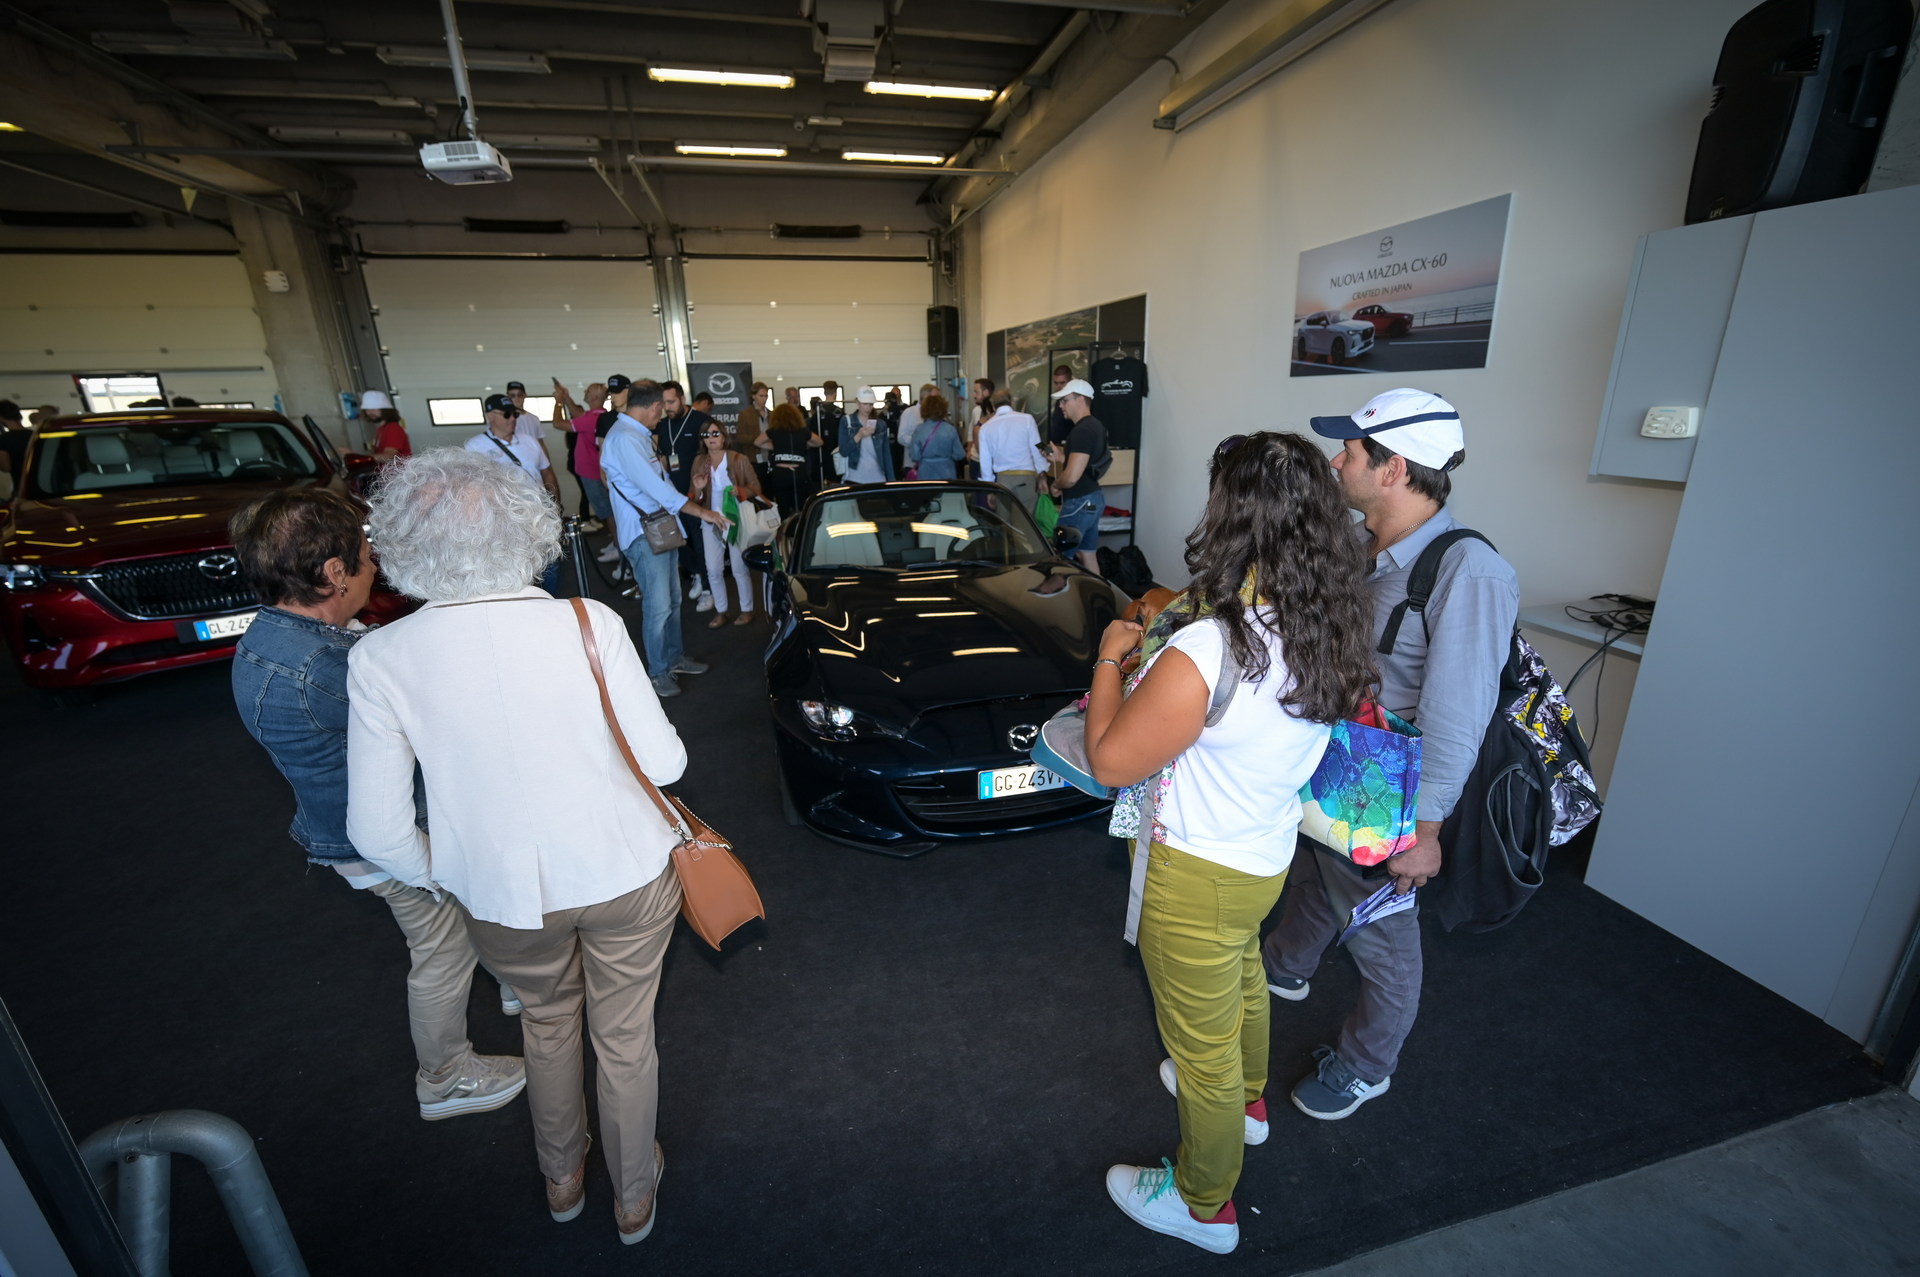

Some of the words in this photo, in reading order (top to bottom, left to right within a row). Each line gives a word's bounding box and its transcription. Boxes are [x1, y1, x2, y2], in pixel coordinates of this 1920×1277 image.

[1329, 271, 1365, 289] NUOVA
[1366, 262, 1408, 281] MAZDA
[1411, 252, 1448, 273] CX-60
[1352, 288, 1381, 301] CRAFTED
[1381, 286, 1390, 296] IN
[1390, 282, 1413, 295] JAPAN
[994, 774, 1013, 792] GG
